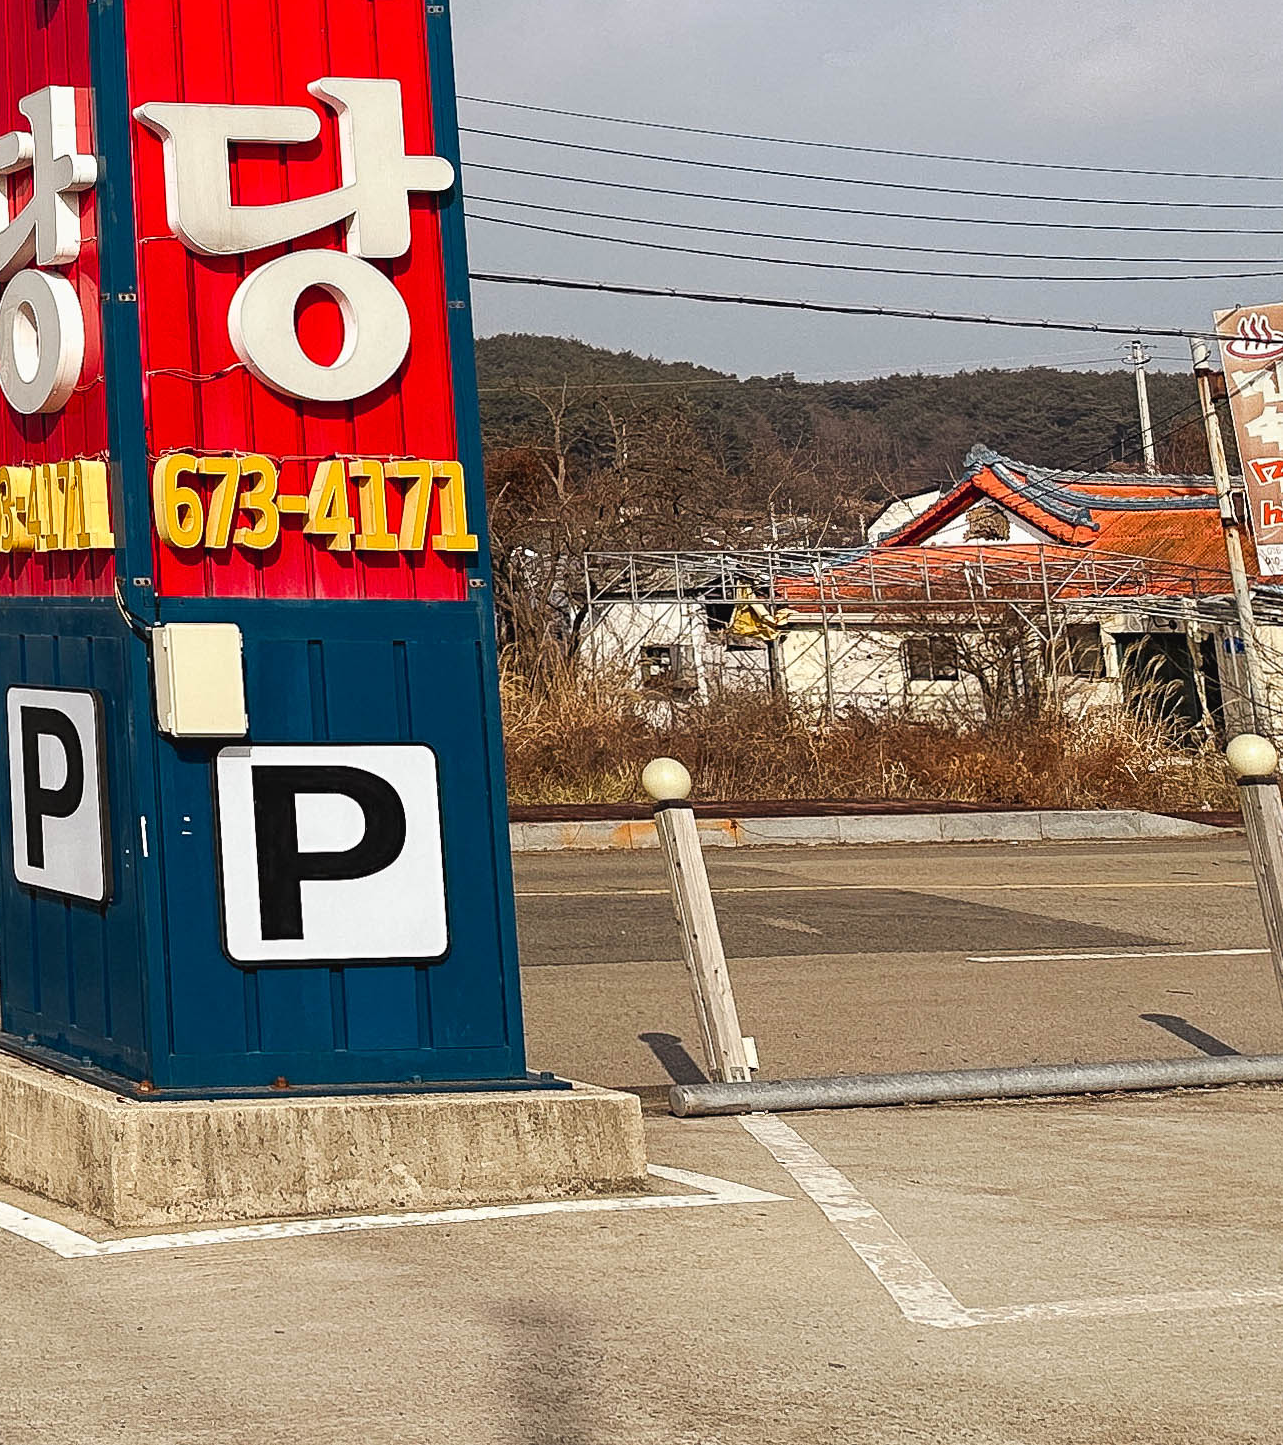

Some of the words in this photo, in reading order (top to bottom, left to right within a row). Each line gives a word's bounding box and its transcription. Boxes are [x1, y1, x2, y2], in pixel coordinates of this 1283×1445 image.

[154, 454, 479, 552] 673-4171
[20, 706, 84, 869] P
[252, 765, 406, 940] P
